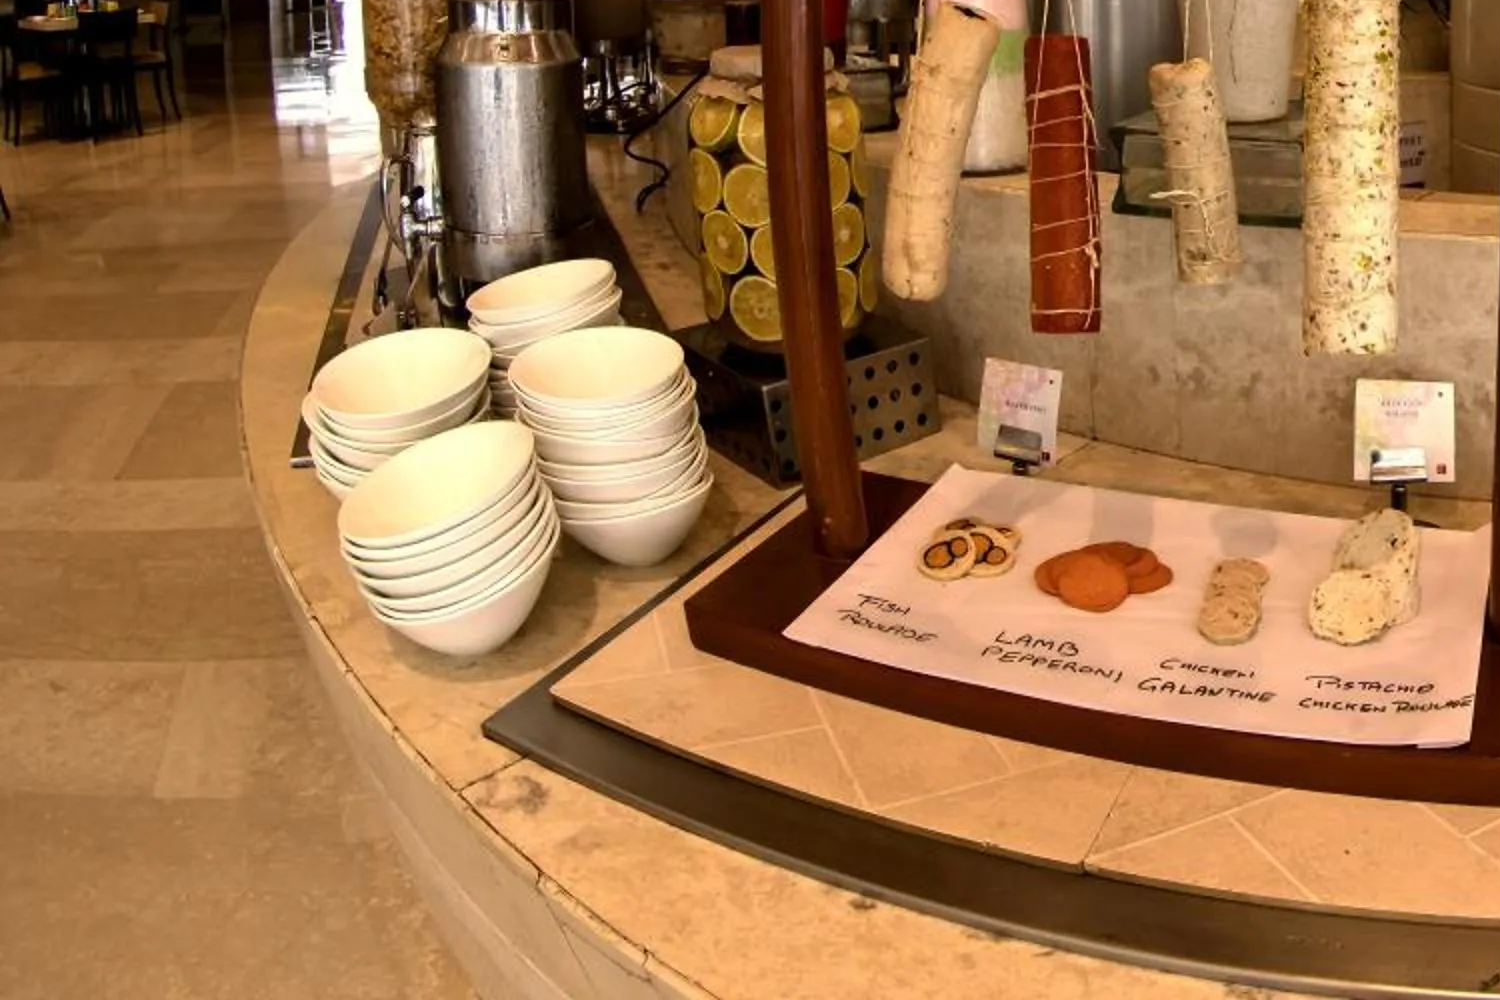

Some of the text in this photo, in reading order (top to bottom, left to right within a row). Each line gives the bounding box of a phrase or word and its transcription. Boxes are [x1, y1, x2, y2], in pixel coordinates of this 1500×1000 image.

[858, 593, 911, 615] FISH
[837, 609, 939, 642] ROULADE
[995, 631, 1079, 657] LAMB
[981, 645, 1123, 683] PEPPERONI
[1159, 658, 1255, 679] CHICKEN
[1137, 677, 1278, 702] GALANTINE
[1305, 675, 1435, 693] PISTACHIO
[1299, 697, 1386, 713] CHICKEN
